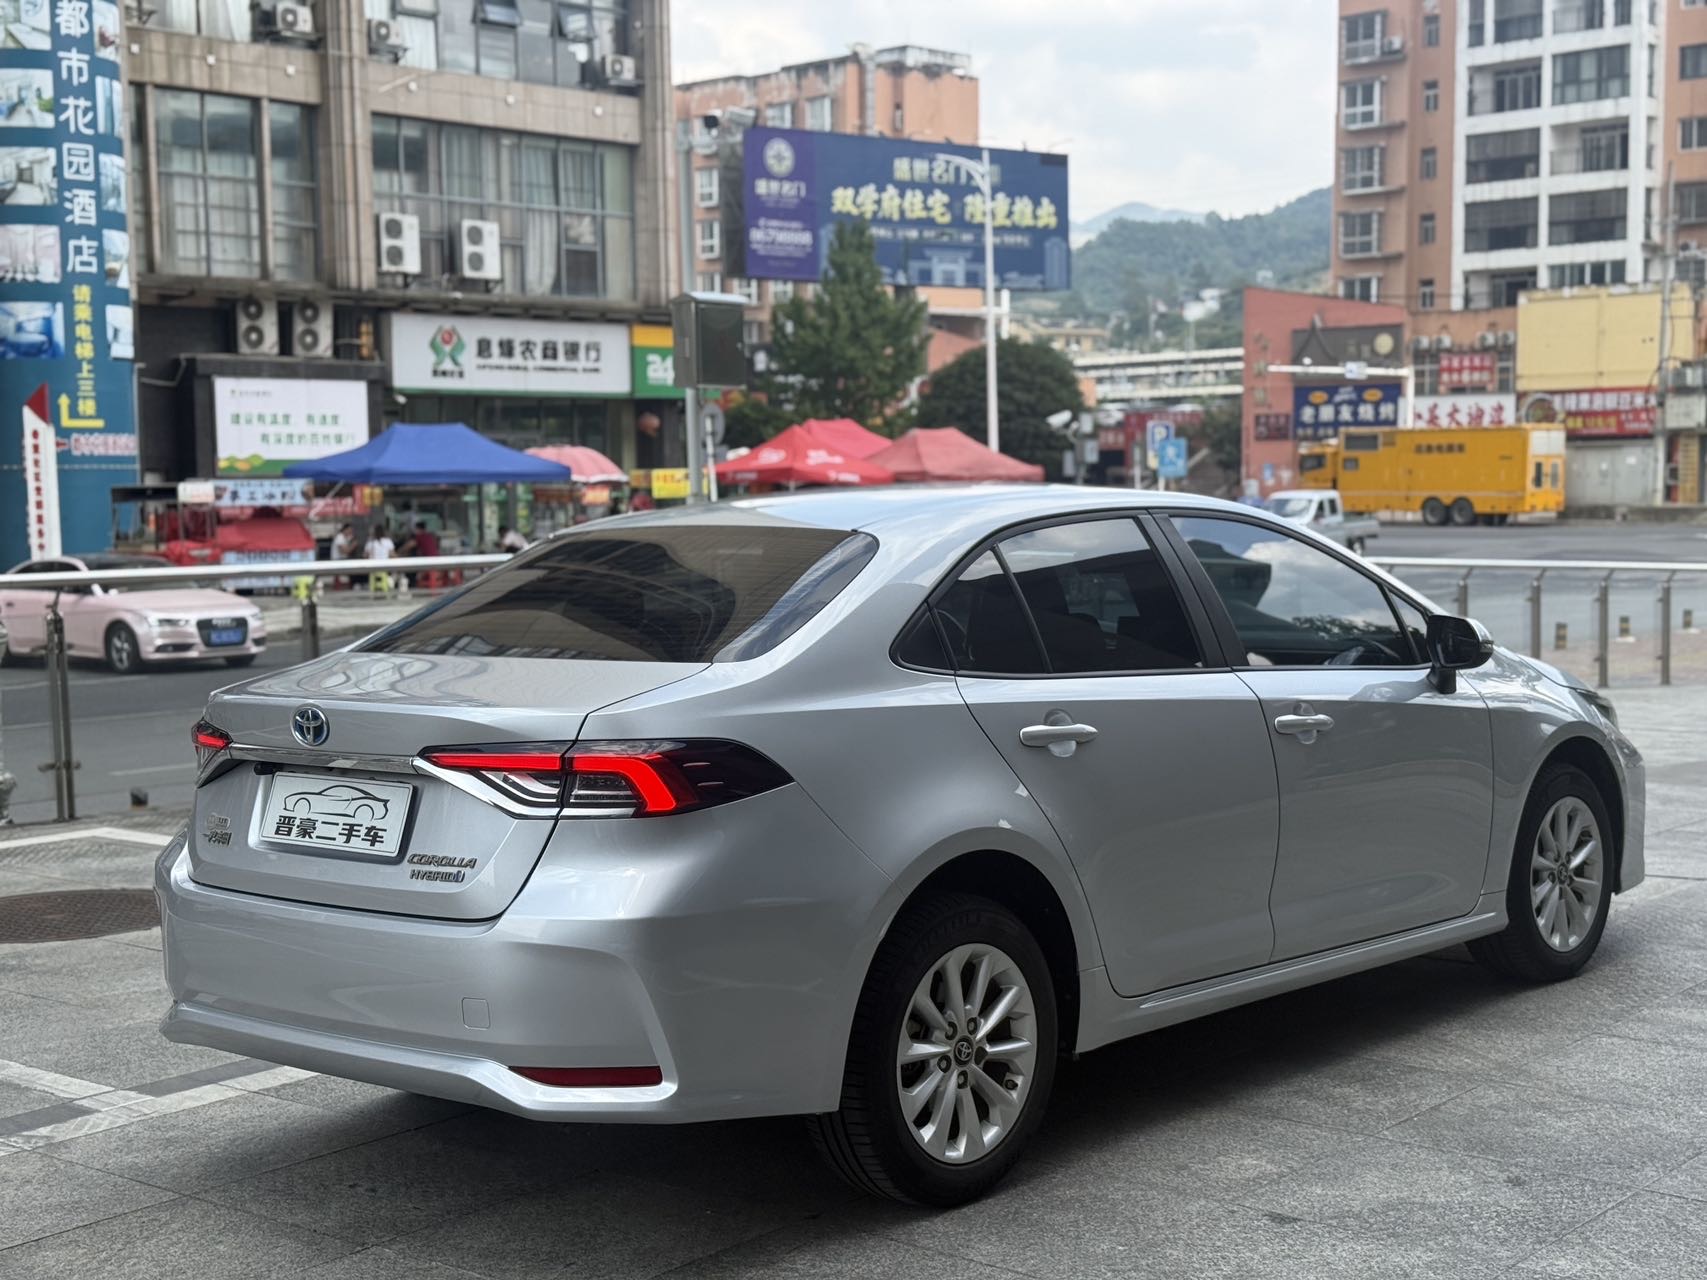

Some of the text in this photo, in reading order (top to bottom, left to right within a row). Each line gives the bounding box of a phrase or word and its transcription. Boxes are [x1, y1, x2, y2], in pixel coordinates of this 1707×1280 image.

[55, 0, 99, 274] 都市花园酒店
[476, 337, 602, 363] 息烽农商银行
[274, 815, 388, 847] 晋豪二手车
[407, 853, 478, 869] COROLLA
